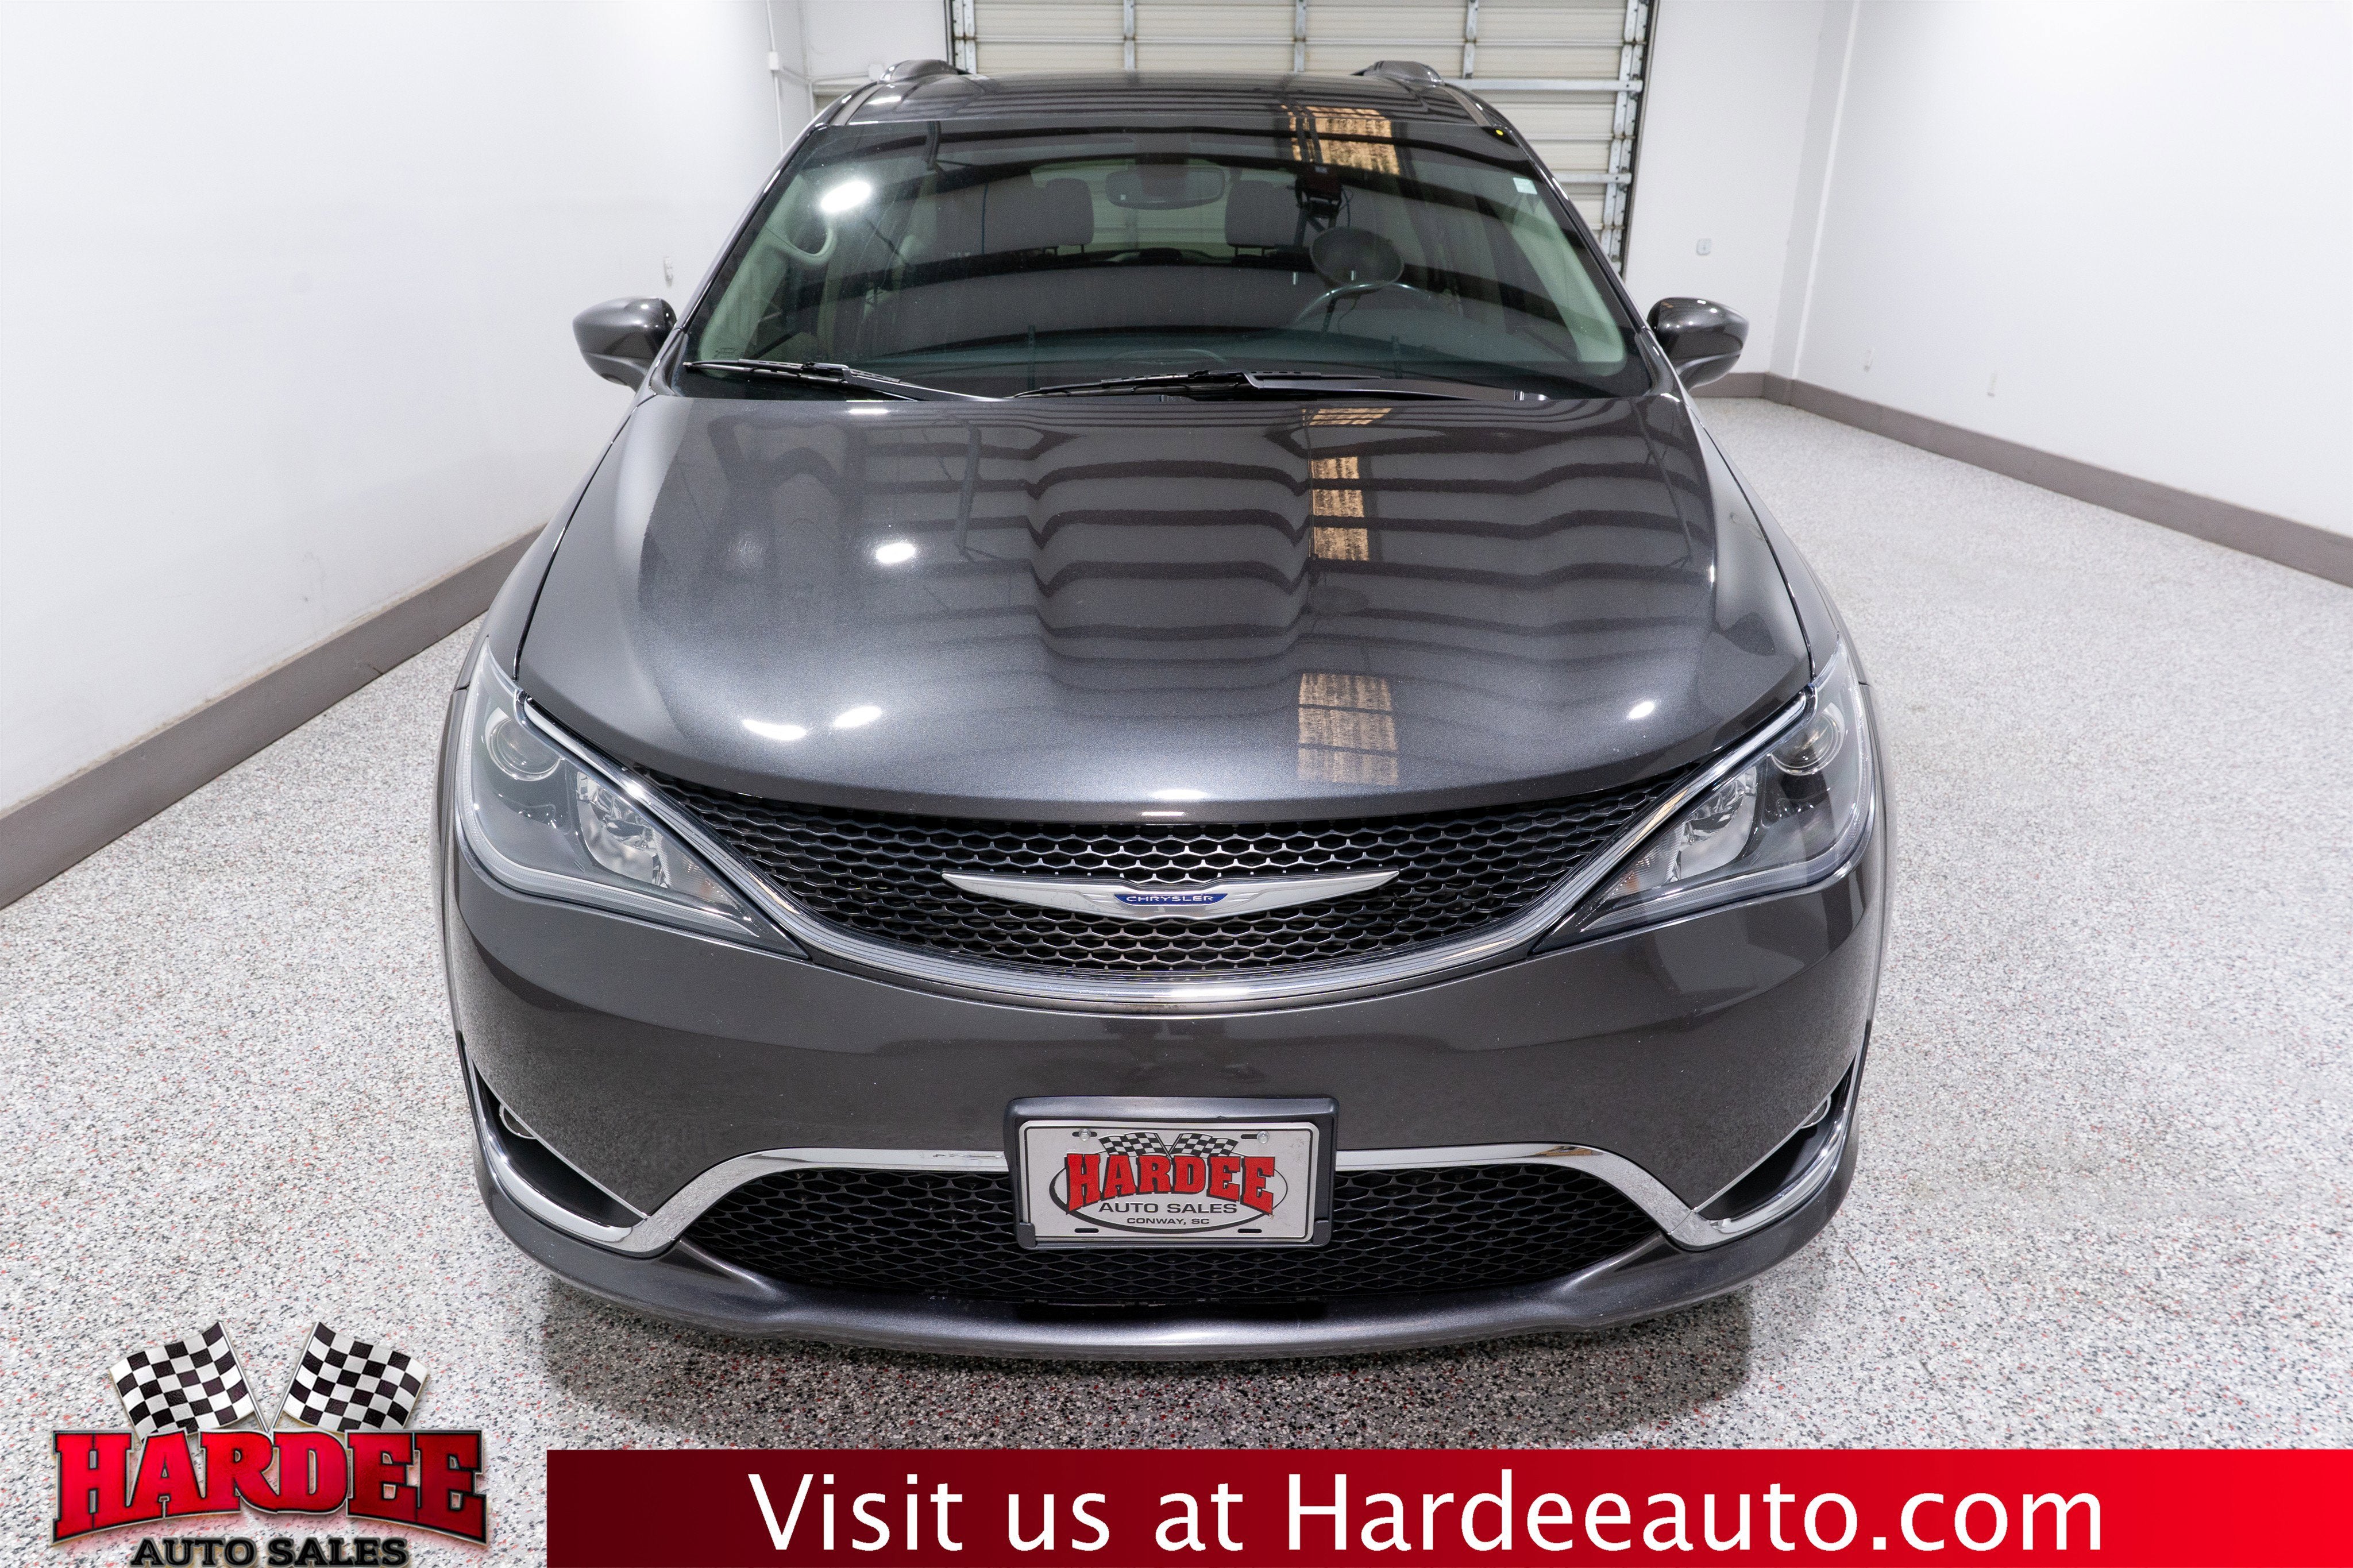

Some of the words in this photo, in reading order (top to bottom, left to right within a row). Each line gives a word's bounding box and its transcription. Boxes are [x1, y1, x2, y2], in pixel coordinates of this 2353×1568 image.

[1063, 1153, 1275, 1215] HARDEE
[1098, 1202, 1159, 1214] AUTO
[1167, 1203, 1238, 1214] SALES
[1126, 1218, 1187, 1226] CONWAY,
